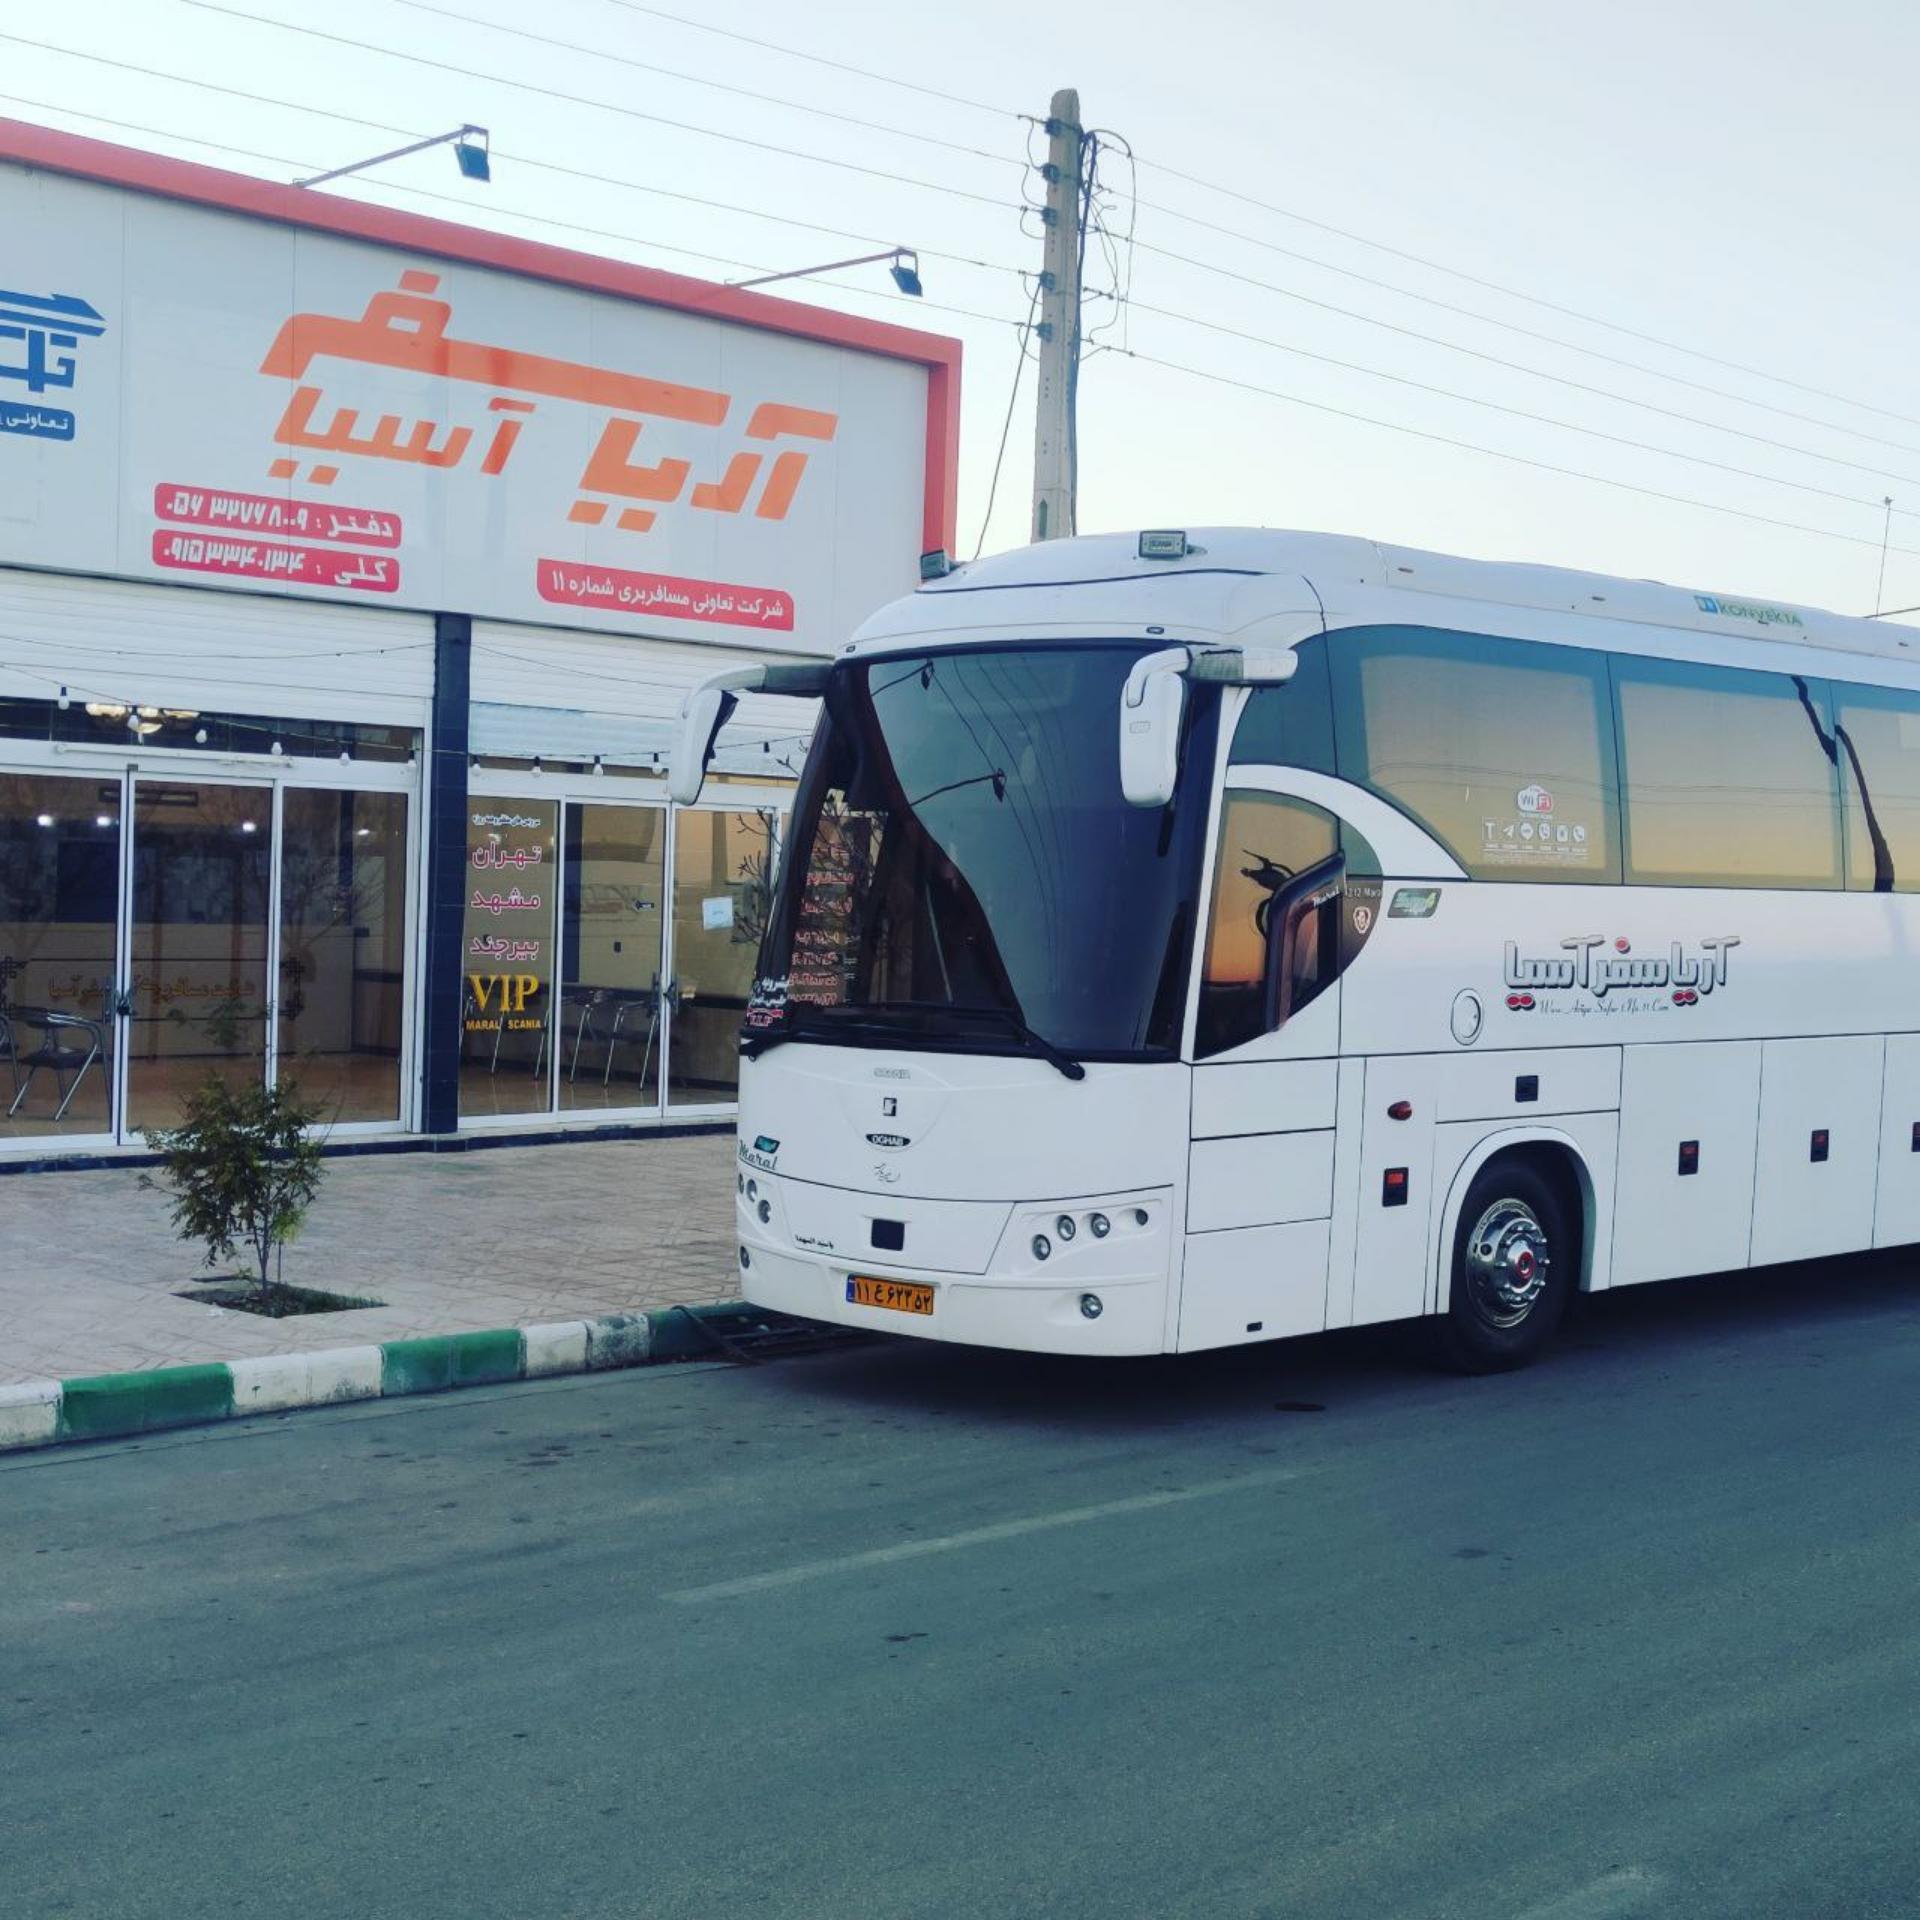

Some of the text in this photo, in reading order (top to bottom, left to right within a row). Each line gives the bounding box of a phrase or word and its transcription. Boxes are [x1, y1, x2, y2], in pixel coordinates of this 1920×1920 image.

[6, 411, 69, 430] تعاونی
[268, 386, 536, 486] آسیا
[568, 402, 838, 532] آریا
[335, 557, 388, 585] کلی
[552, 569, 564, 592] ۱۱
[569, 576, 615, 598] شماره
[693, 592, 733, 615] تعاونی
[737, 599, 784, 620] شرکت
[472, 841, 542, 870] تهران
[471, 887, 541, 915] مشهد
[469, 936, 539, 960] بیرجند
[1504, 934, 1742, 1011] آریا سفر آسیا
[469, 974, 539, 1012] VIP
[466, 1019, 541, 1030] MARAL SCANIA
[739, 1139, 778, 1171] Maral
